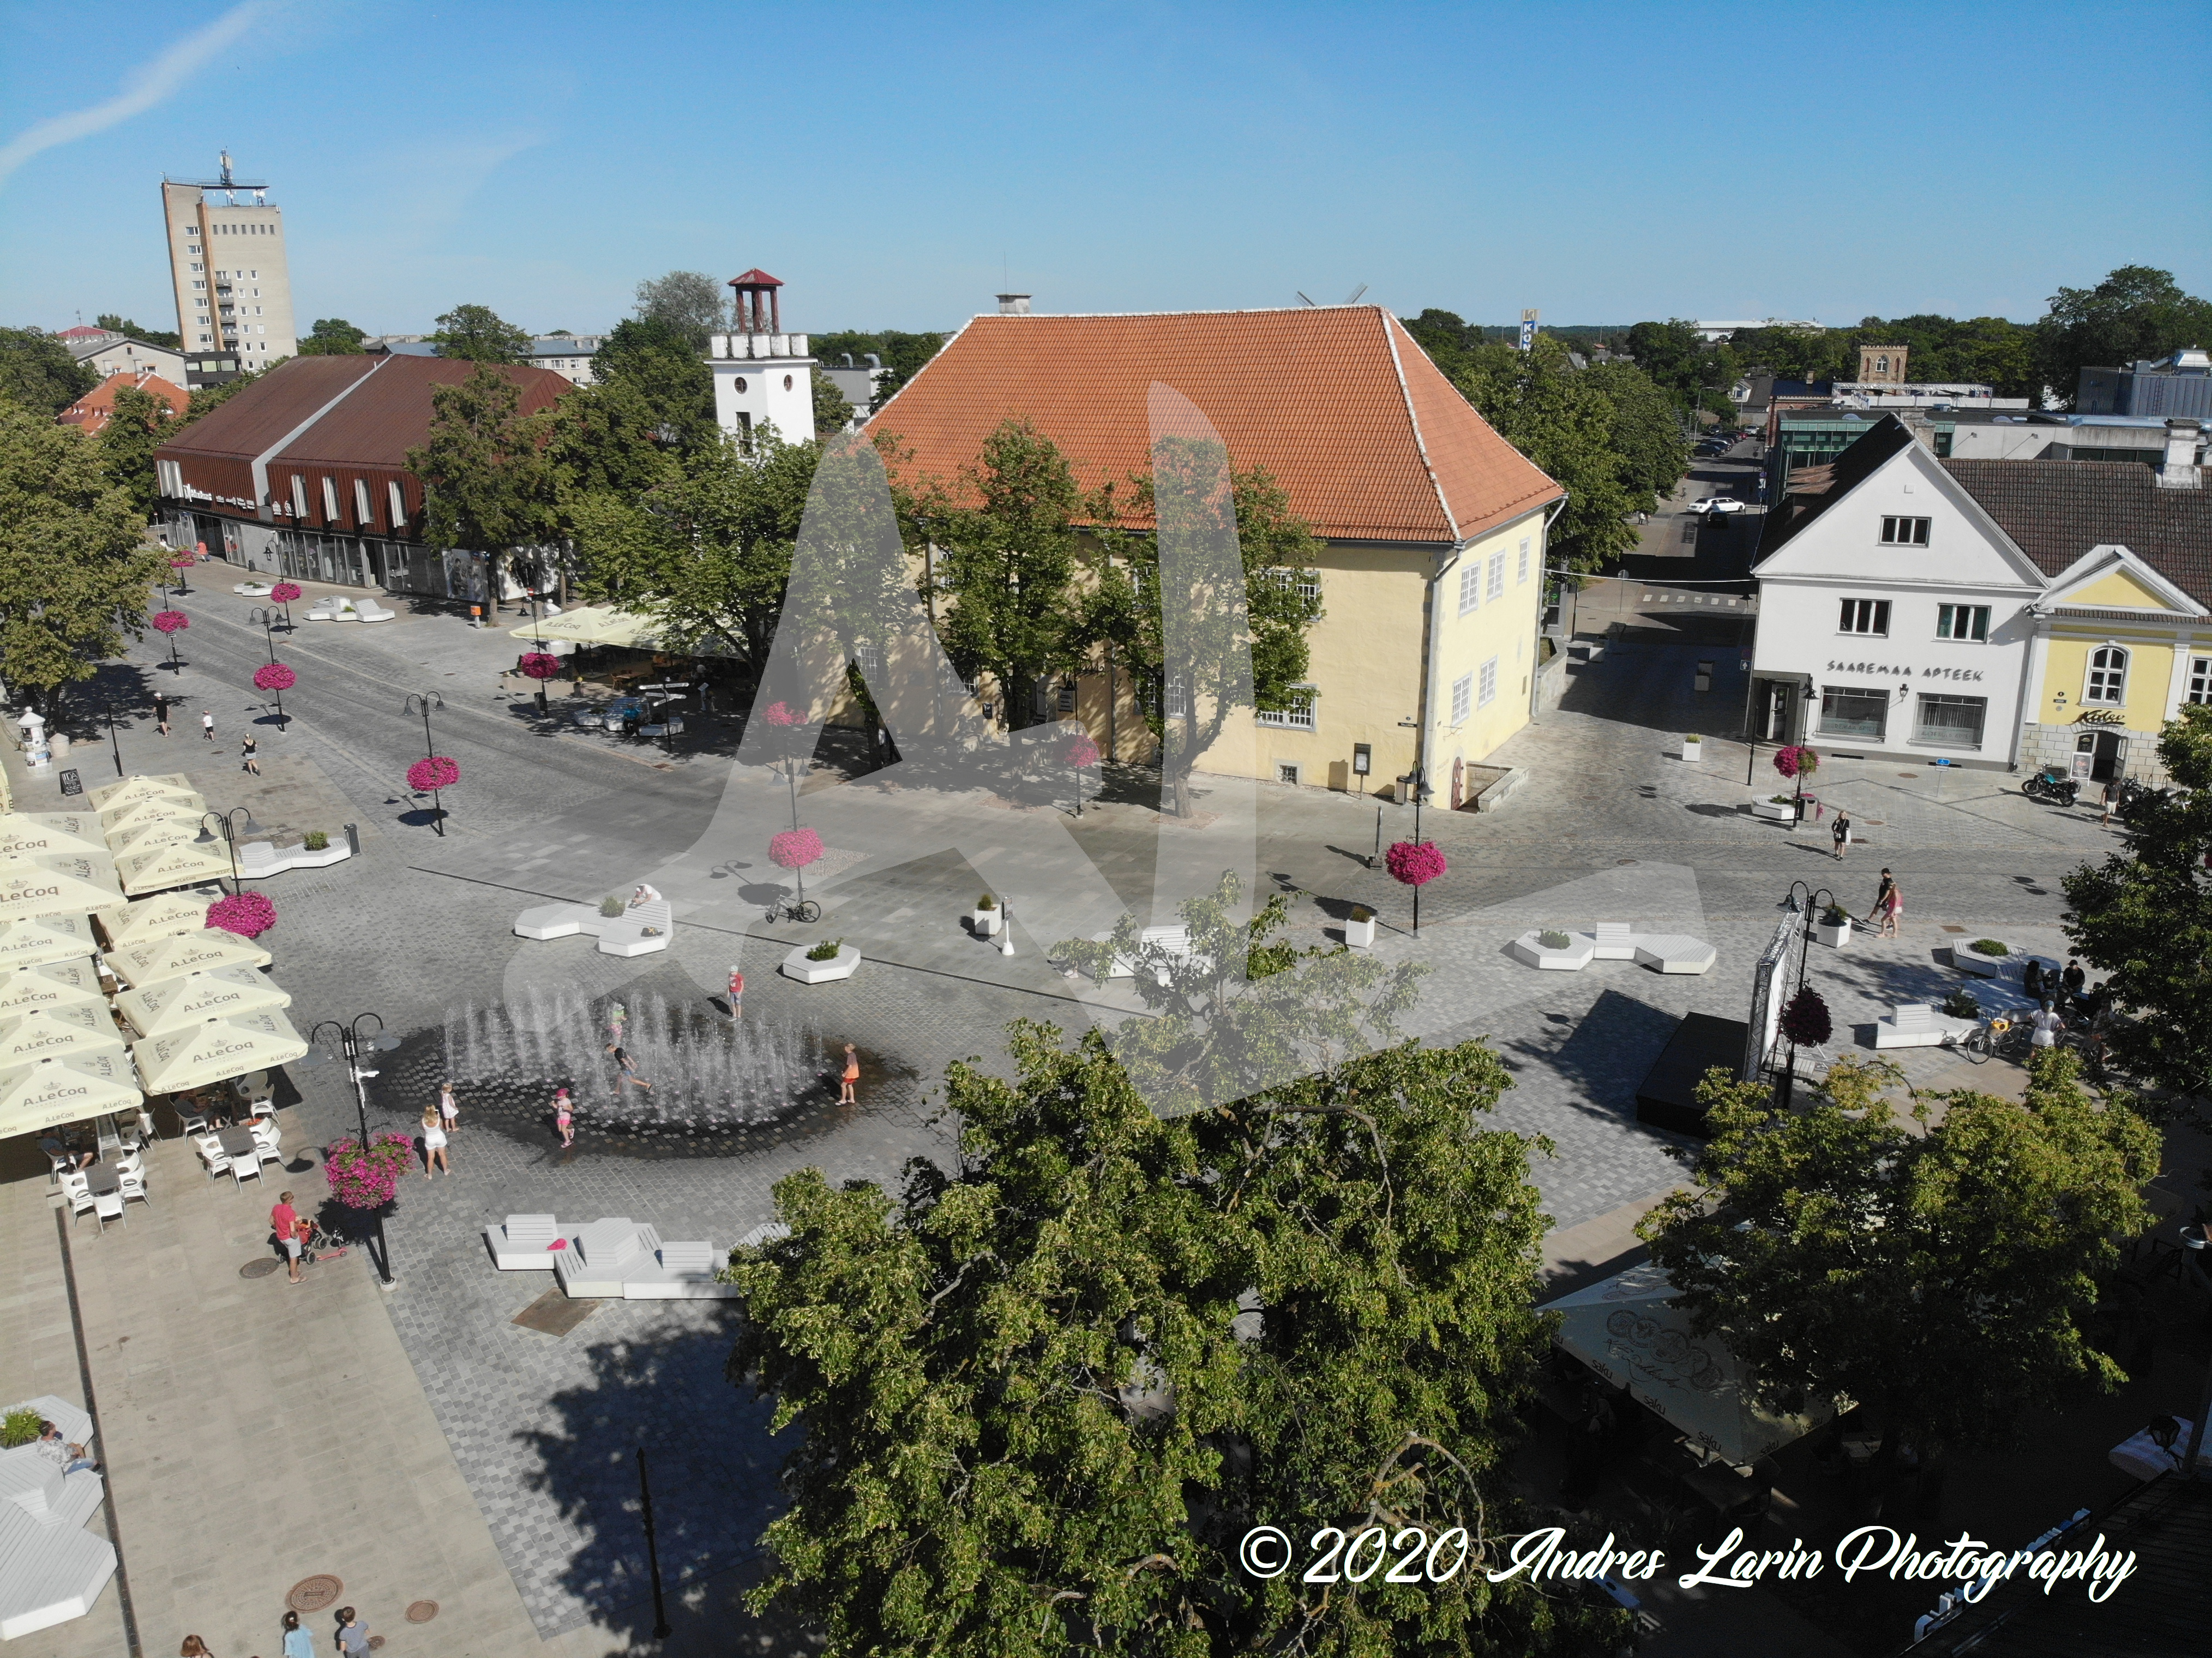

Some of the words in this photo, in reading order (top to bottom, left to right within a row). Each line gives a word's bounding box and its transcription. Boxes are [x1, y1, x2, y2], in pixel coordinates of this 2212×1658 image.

[545, 621, 581, 630] A.LeCoq
[1827, 659, 1913, 677] SAAREMAA
[1921, 666, 1985, 682] APTEEK
[2071, 710, 2126, 726] Kalev
[124, 789, 165, 800] A.LeCoq
[134, 810, 176, 822] A.LeCoq
[143, 834, 188, 846] A.LeCoq
[157, 861, 205, 873] A.LeCoq
[149, 910, 199, 926] A.LeCoq
[1, 939, 53, 953] A.LeCoq
[123, 939, 146, 948] A.LeCoq
[64, 950, 88, 958] A.LeCoq
[171, 951, 224, 969] A.LeCoq
[19, 958, 43, 966] A.LeCoq
[1, 993, 57, 1008] A.LeCoq
[184, 992, 241, 1013] A.LeCoq
[81, 1008, 98, 1026] A.LeCoq
[14, 1035, 75, 1054] A.LeCoq
[193, 1041, 255, 1064] A.LeCoq
[270, 1051, 298, 1062] A.LeCoq
[97, 1056, 113, 1077] A.LeCoq
[216, 1065, 244, 1078] A.LeCoq
[161, 1081, 190, 1094] A.LeCoq
[23, 1086, 88, 1107] A.LeCoq
[103, 1098, 132, 1110] A.LeCoq
[45, 1112, 75, 1124] A.LeCoq
[1592, 1357, 1613, 1380] saku
[1643, 1394, 1667, 1416] saku
[1698, 1431, 1722, 1453] saku
